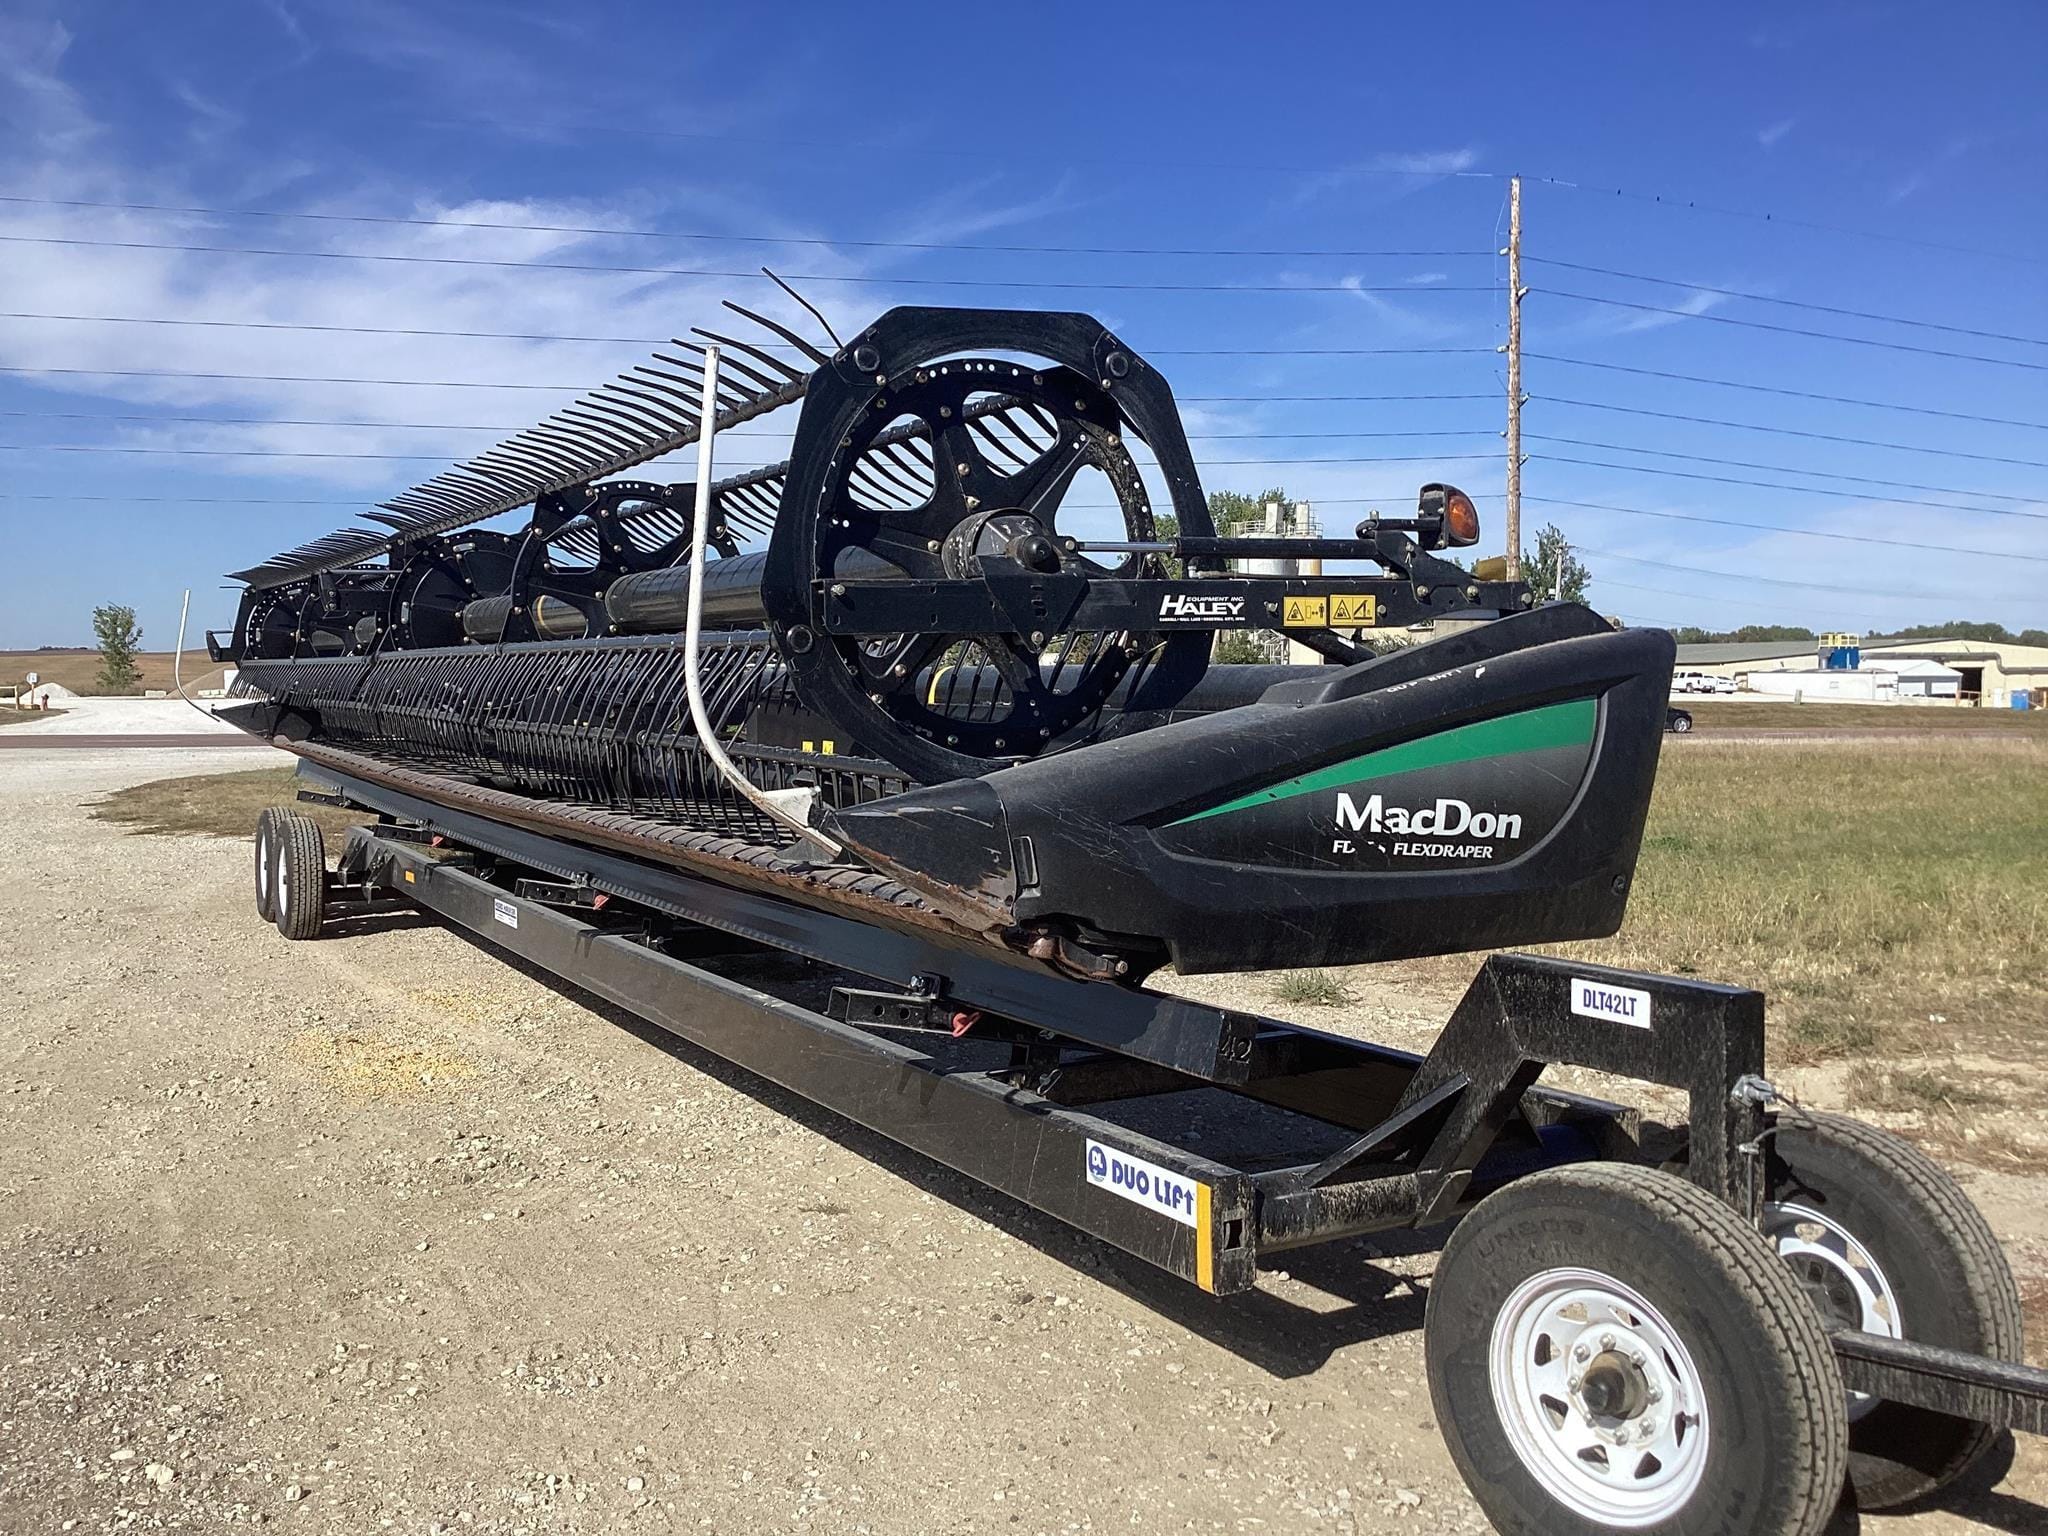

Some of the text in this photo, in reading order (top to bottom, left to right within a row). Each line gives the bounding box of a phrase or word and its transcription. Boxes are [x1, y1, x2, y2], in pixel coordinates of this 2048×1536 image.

[1160, 595, 1245, 616] HALEY
[1335, 792, 1522, 839] MacDon
[1393, 842, 1493, 859] FLEXDRAPER
[1583, 988, 1637, 1017] DLT42LT
[1111, 1158, 1150, 1196] DUO
